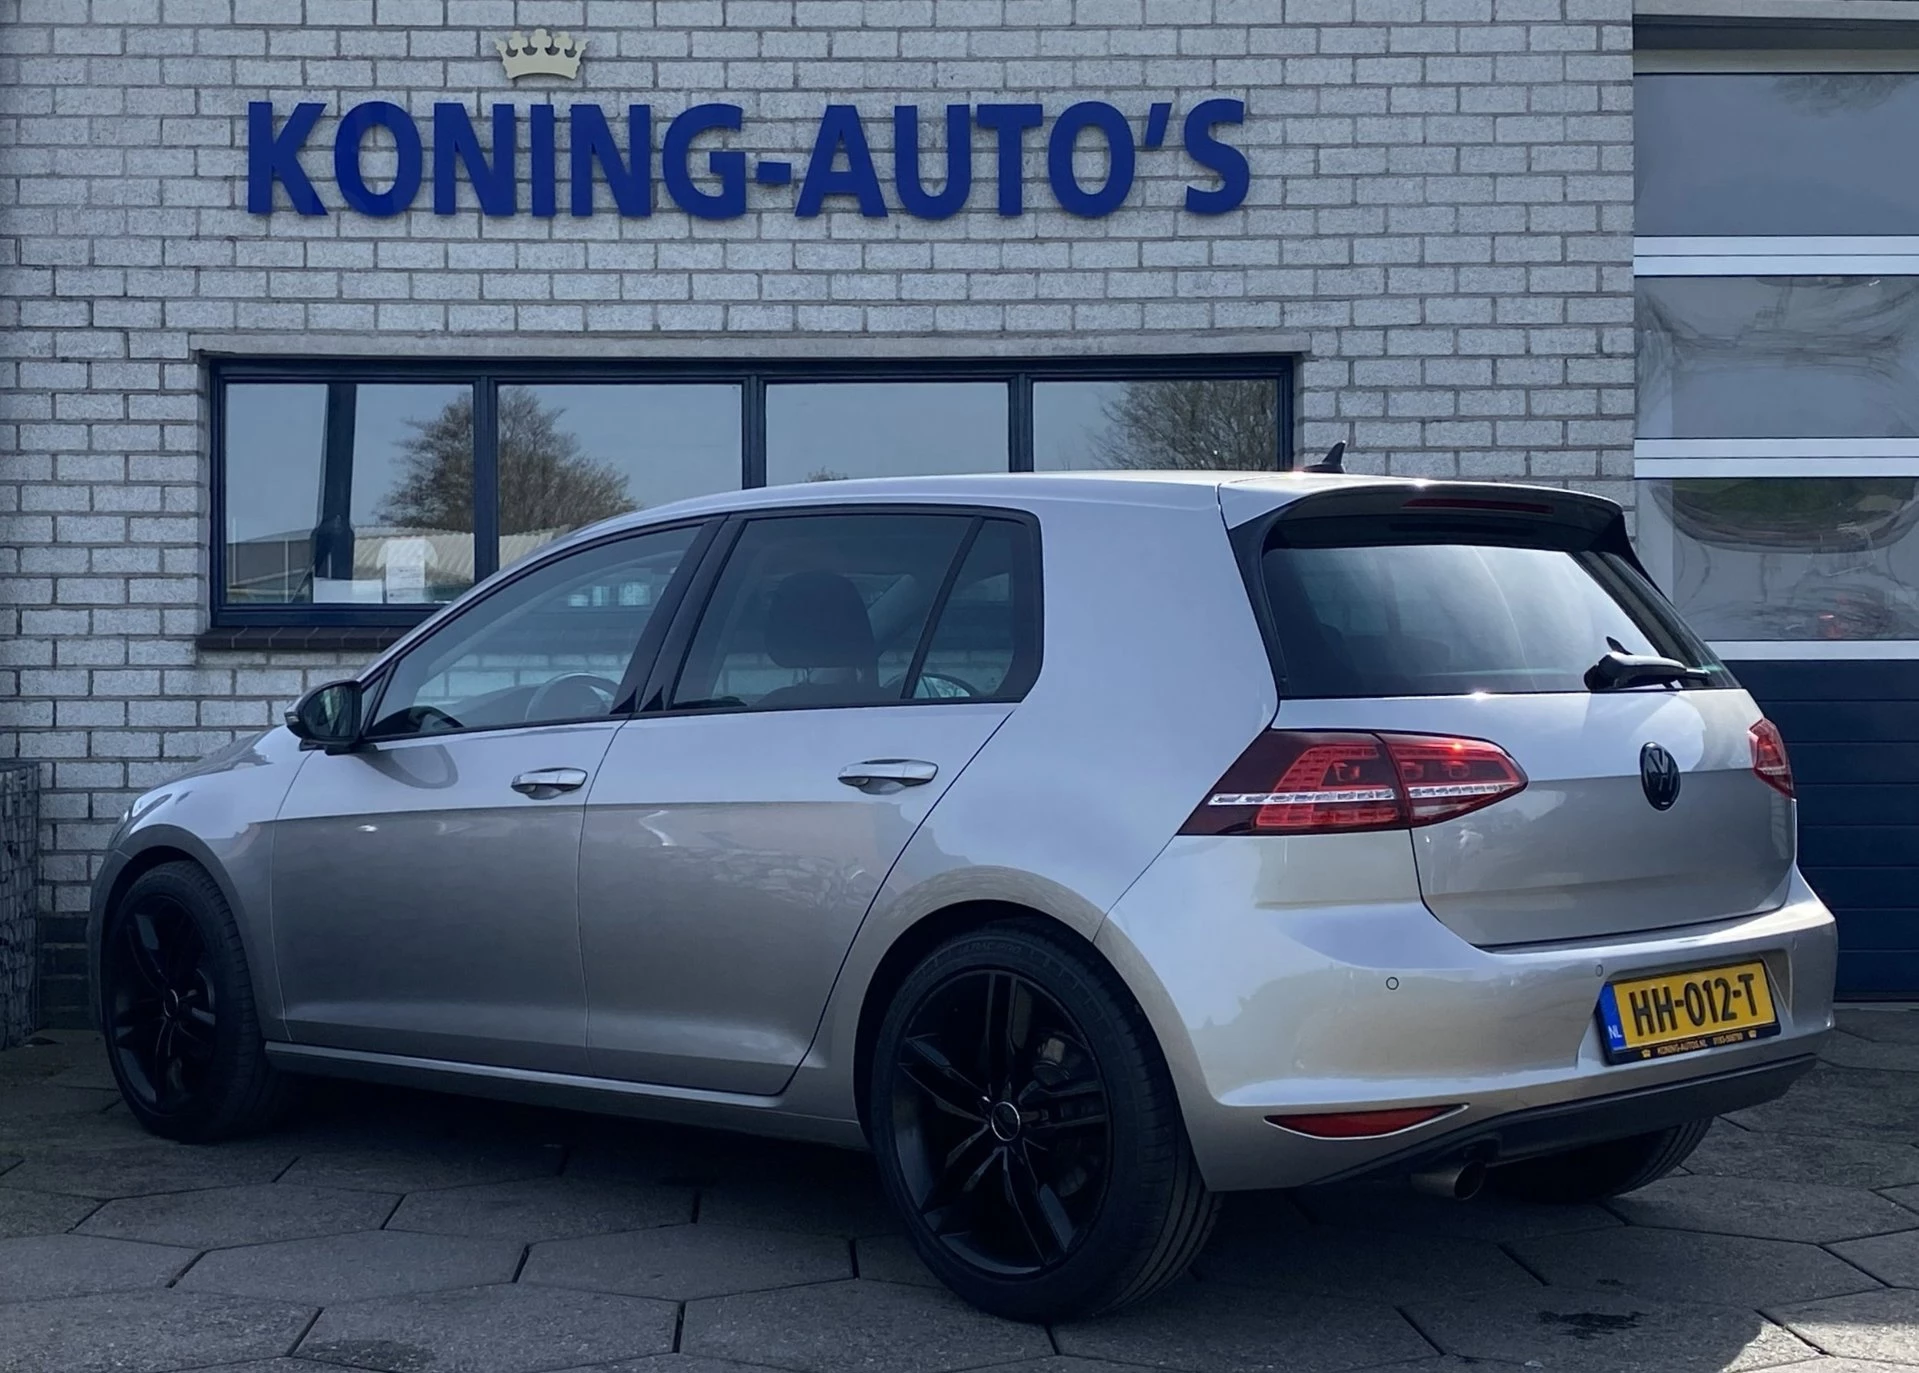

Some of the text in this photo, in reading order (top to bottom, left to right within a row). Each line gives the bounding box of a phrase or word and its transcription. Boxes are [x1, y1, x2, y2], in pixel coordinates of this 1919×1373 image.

[247, 98, 1250, 219] KONING-AUTO'S
[1608, 1024, 1623, 1039] NL
[1629, 973, 1758, 1037] HH-012-T
